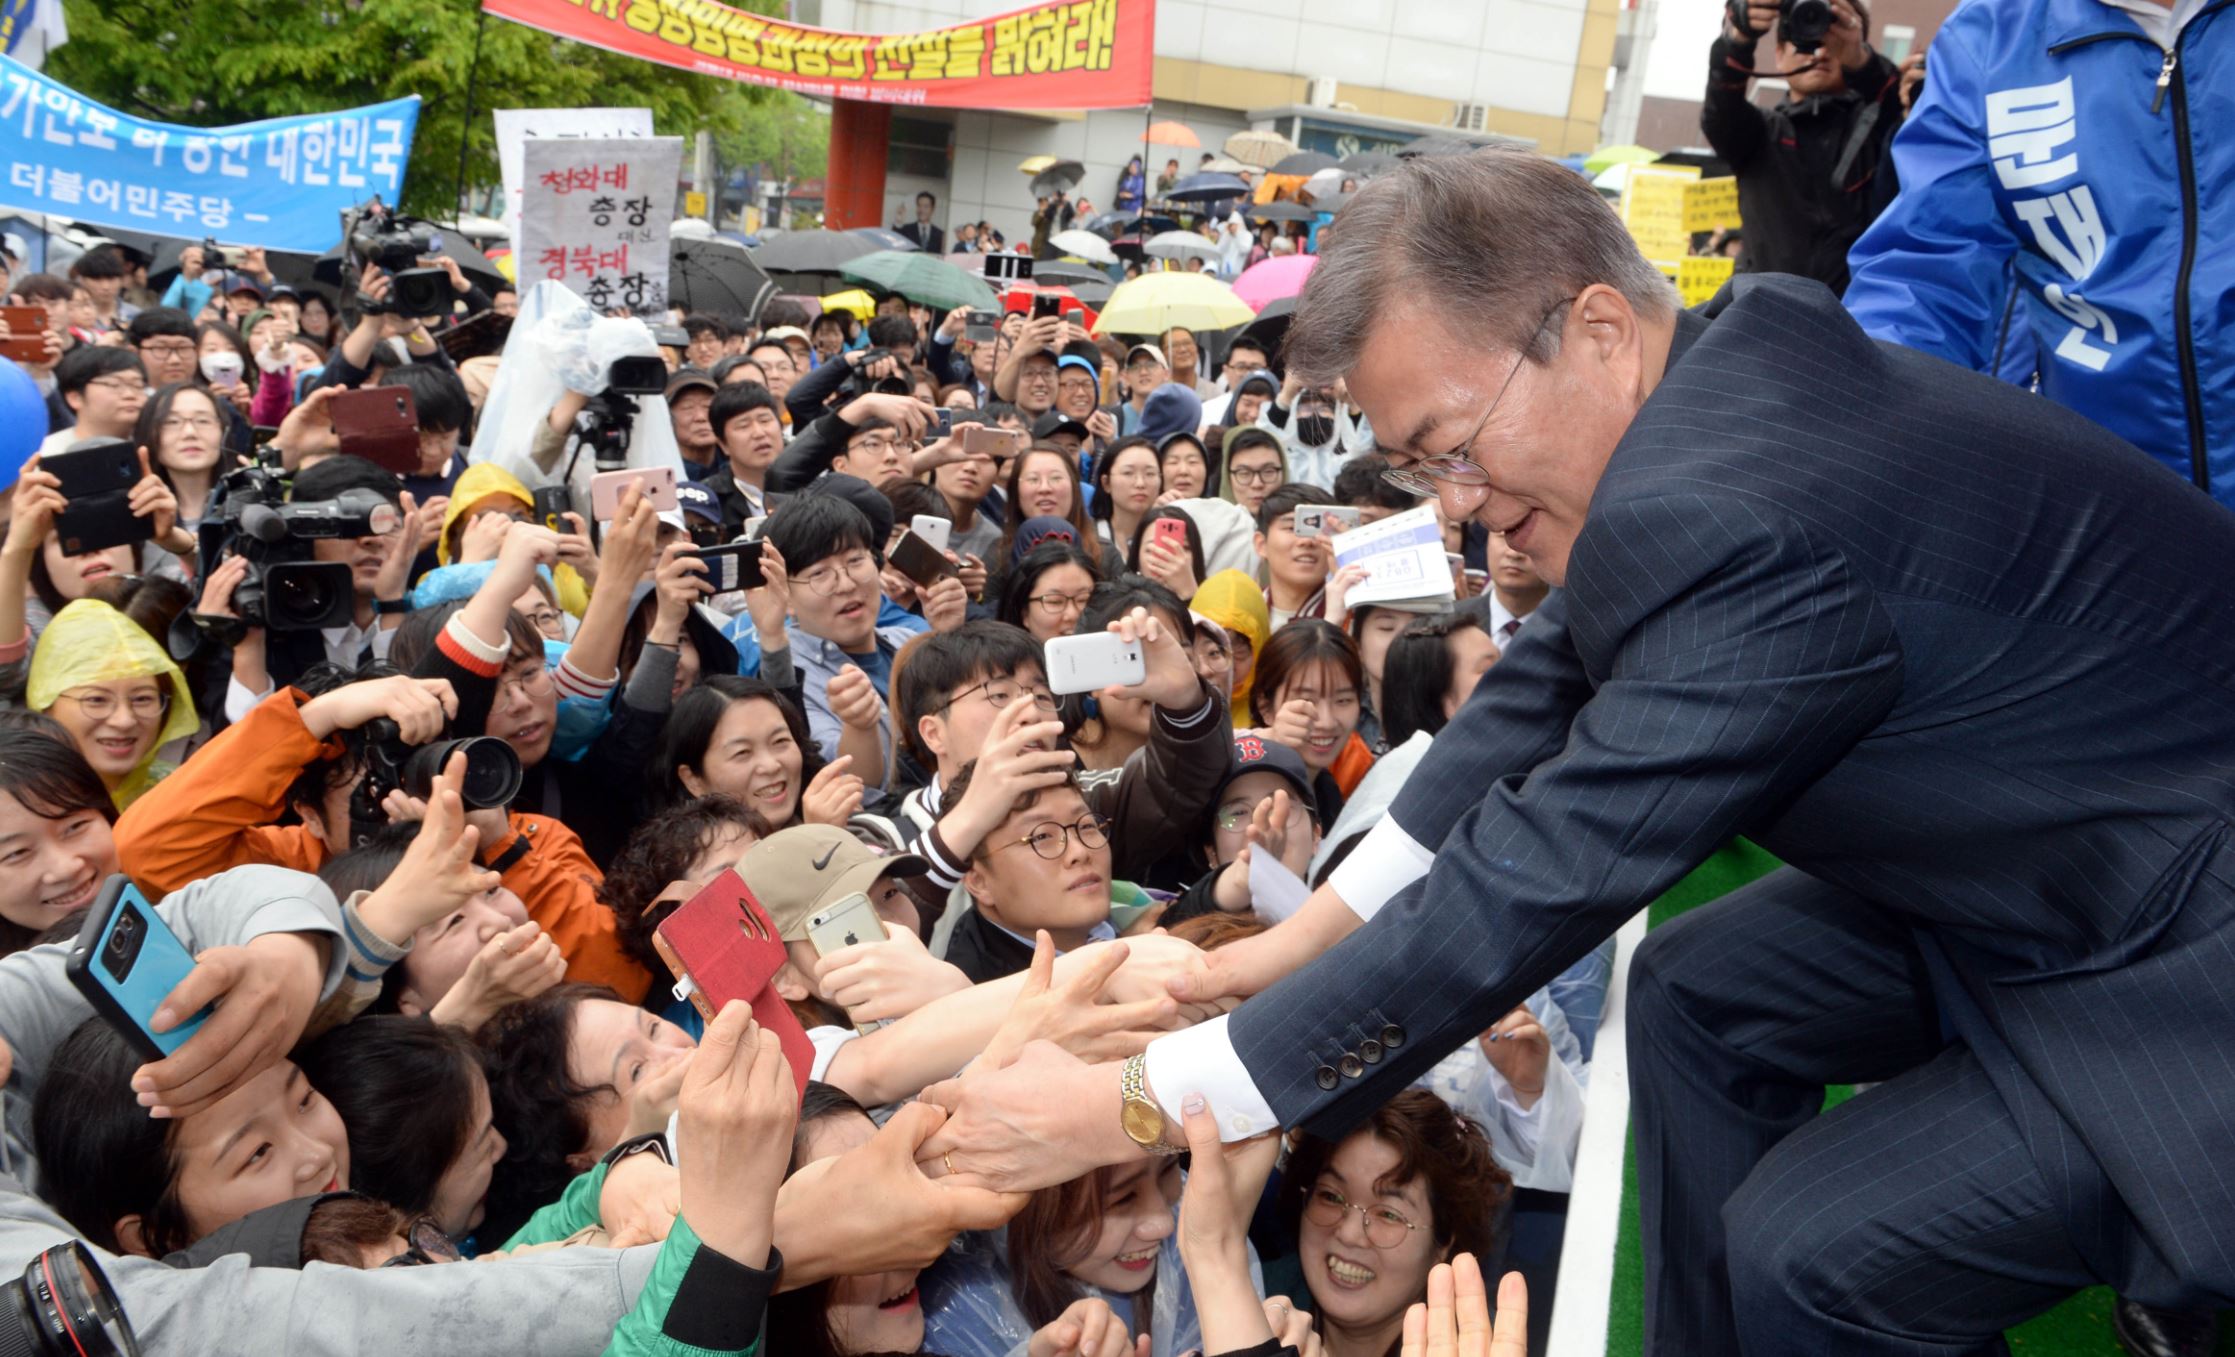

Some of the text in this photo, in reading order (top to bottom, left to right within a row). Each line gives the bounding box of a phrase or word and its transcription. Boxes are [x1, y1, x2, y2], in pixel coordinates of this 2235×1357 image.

[991, 0, 1118, 77] 밝혀라!
[0, 72, 118, 152] 가안보
[265, 117, 403, 190] 대한민국
[10, 161, 234, 229] 더불어민주당
[1986, 75, 2119, 372] 문재인
[539, 244, 629, 281] 경북대
[676, 488, 708, 501] eep
[1234, 736, 1267, 763] B
